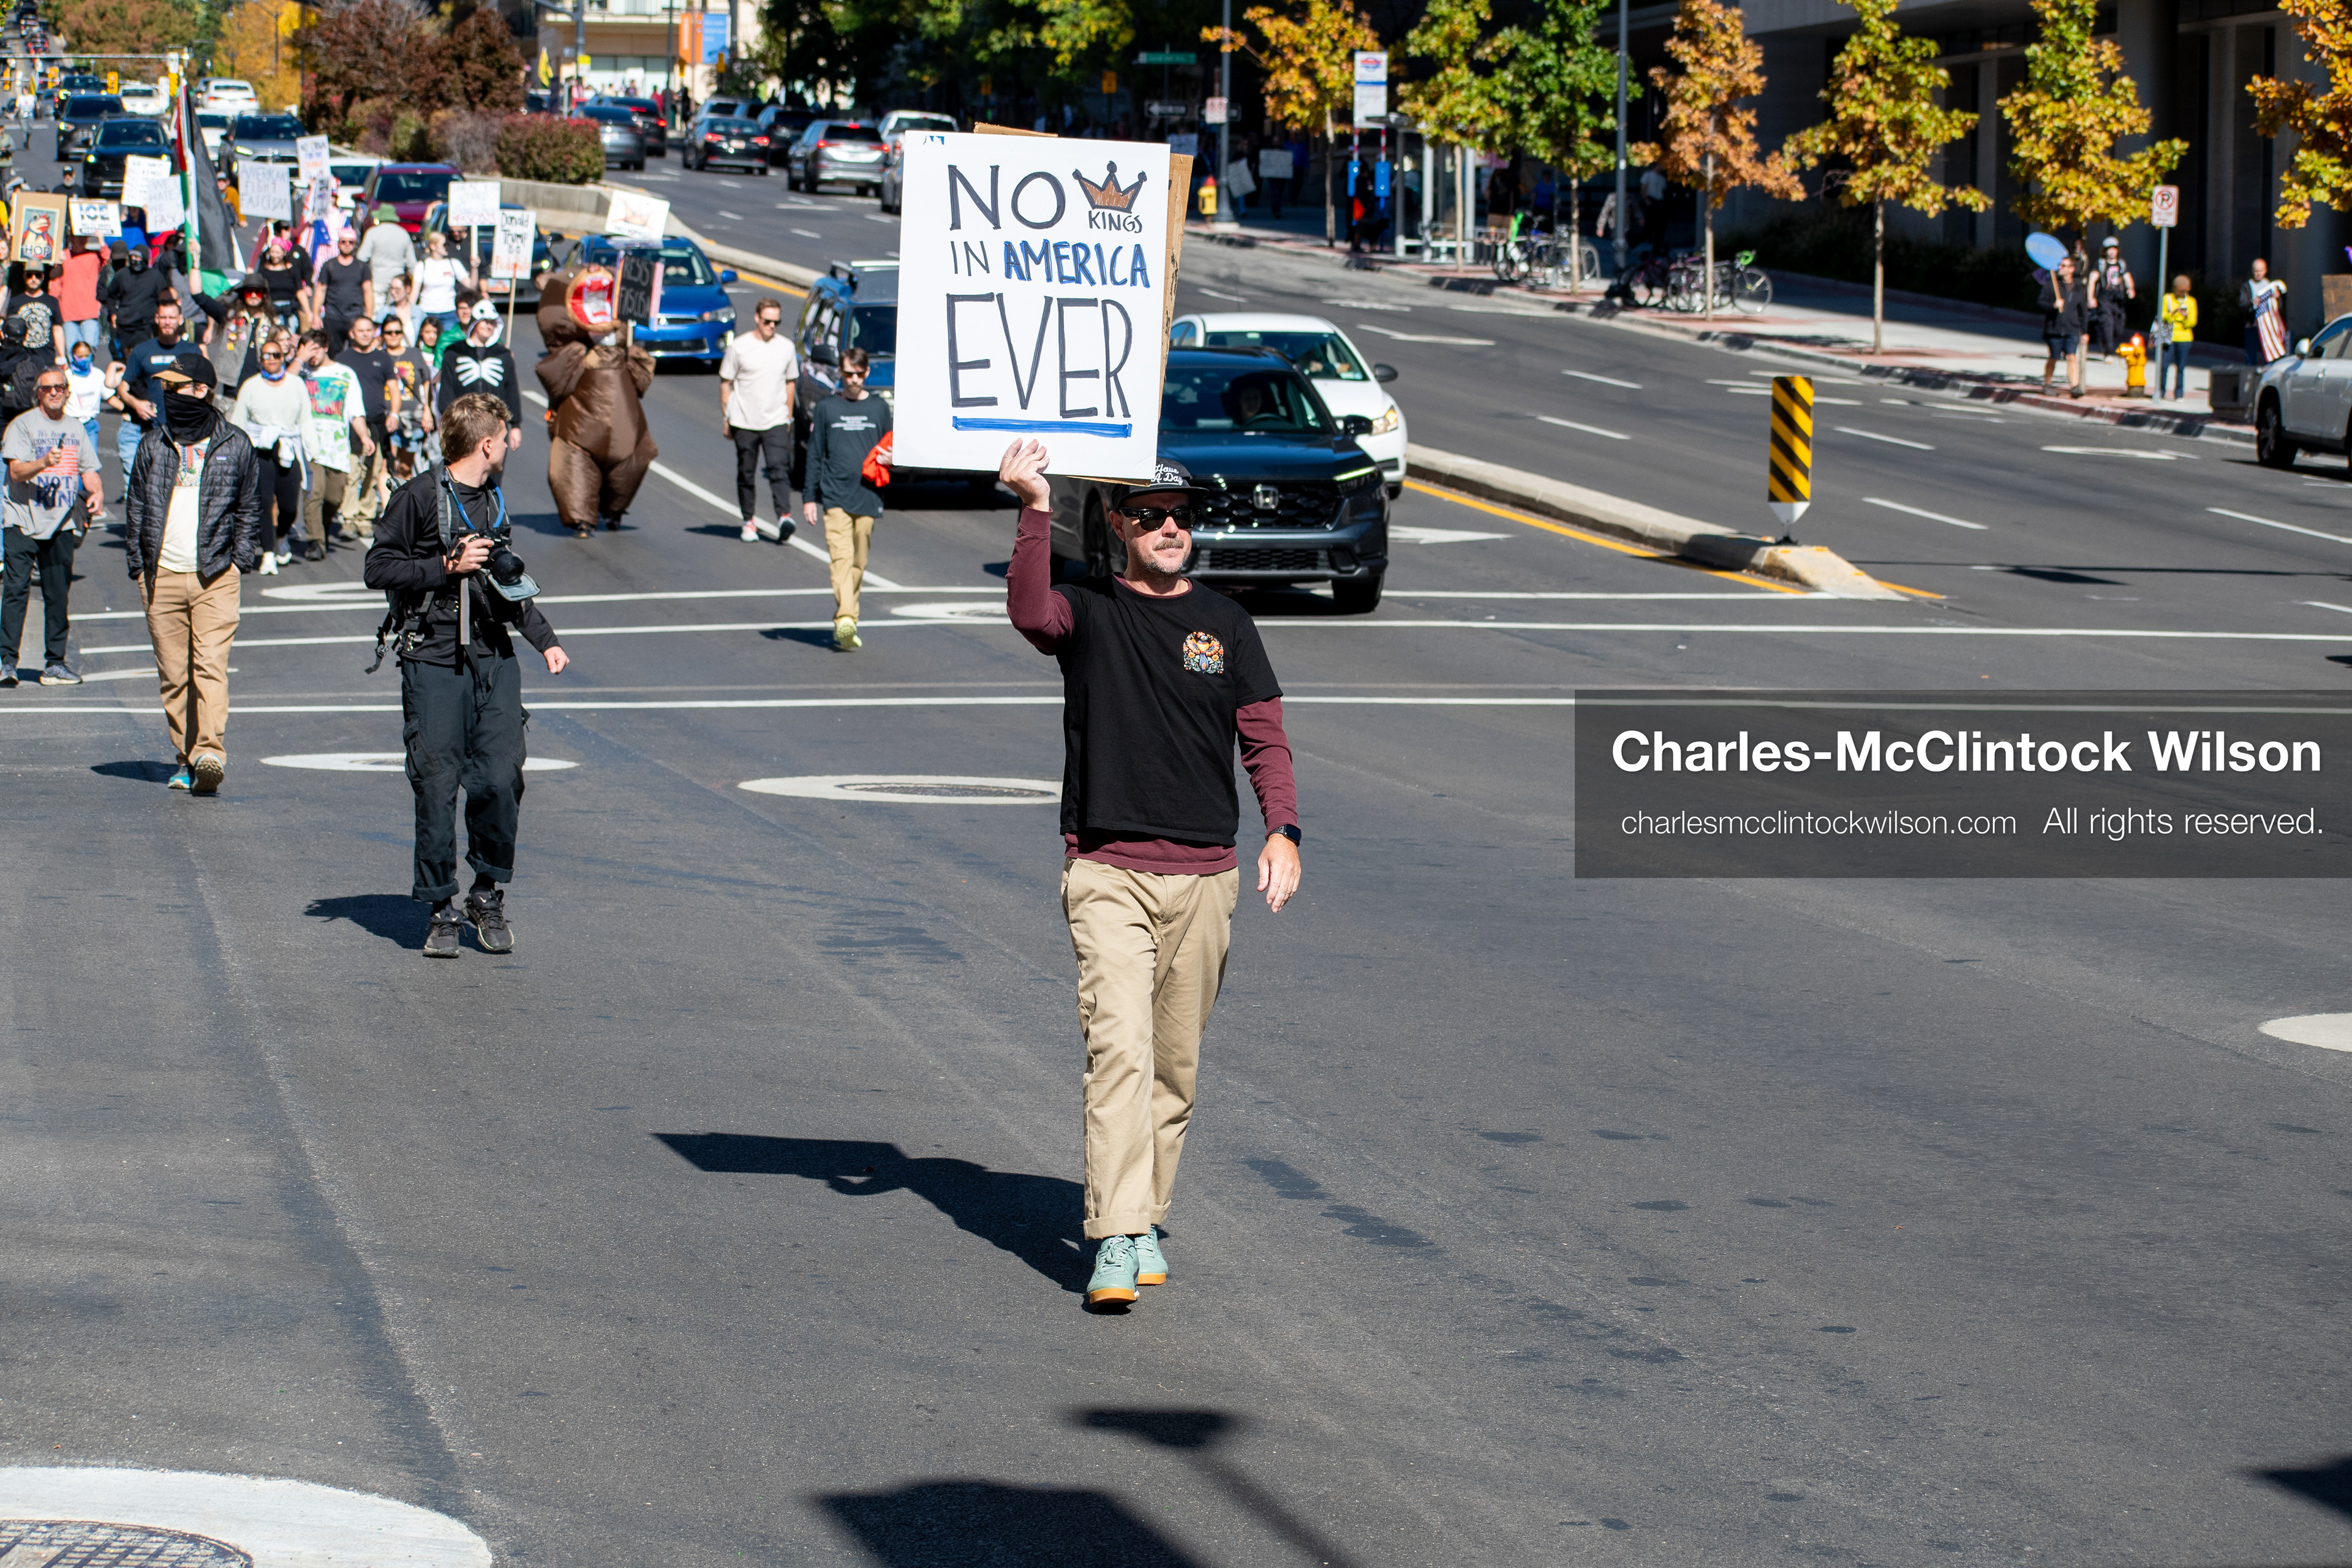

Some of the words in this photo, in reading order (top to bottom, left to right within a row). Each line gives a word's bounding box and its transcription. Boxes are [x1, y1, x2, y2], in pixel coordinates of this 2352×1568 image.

[948, 164, 1066, 230] NO
[501, 212, 529, 228] Donald
[1088, 210, 1143, 233] KINGS
[950, 241, 990, 277] IN
[1003, 238, 1151, 288] AMERICA
[946, 292, 1133, 418] EVER
[32, 438, 81, 447] CONSTIUTION
[1155, 464, 1179, 474] Have
[37, 475, 72, 489] NOT
[1151, 472, 1162, 483] A
[1163, 473, 1183, 486] Day
